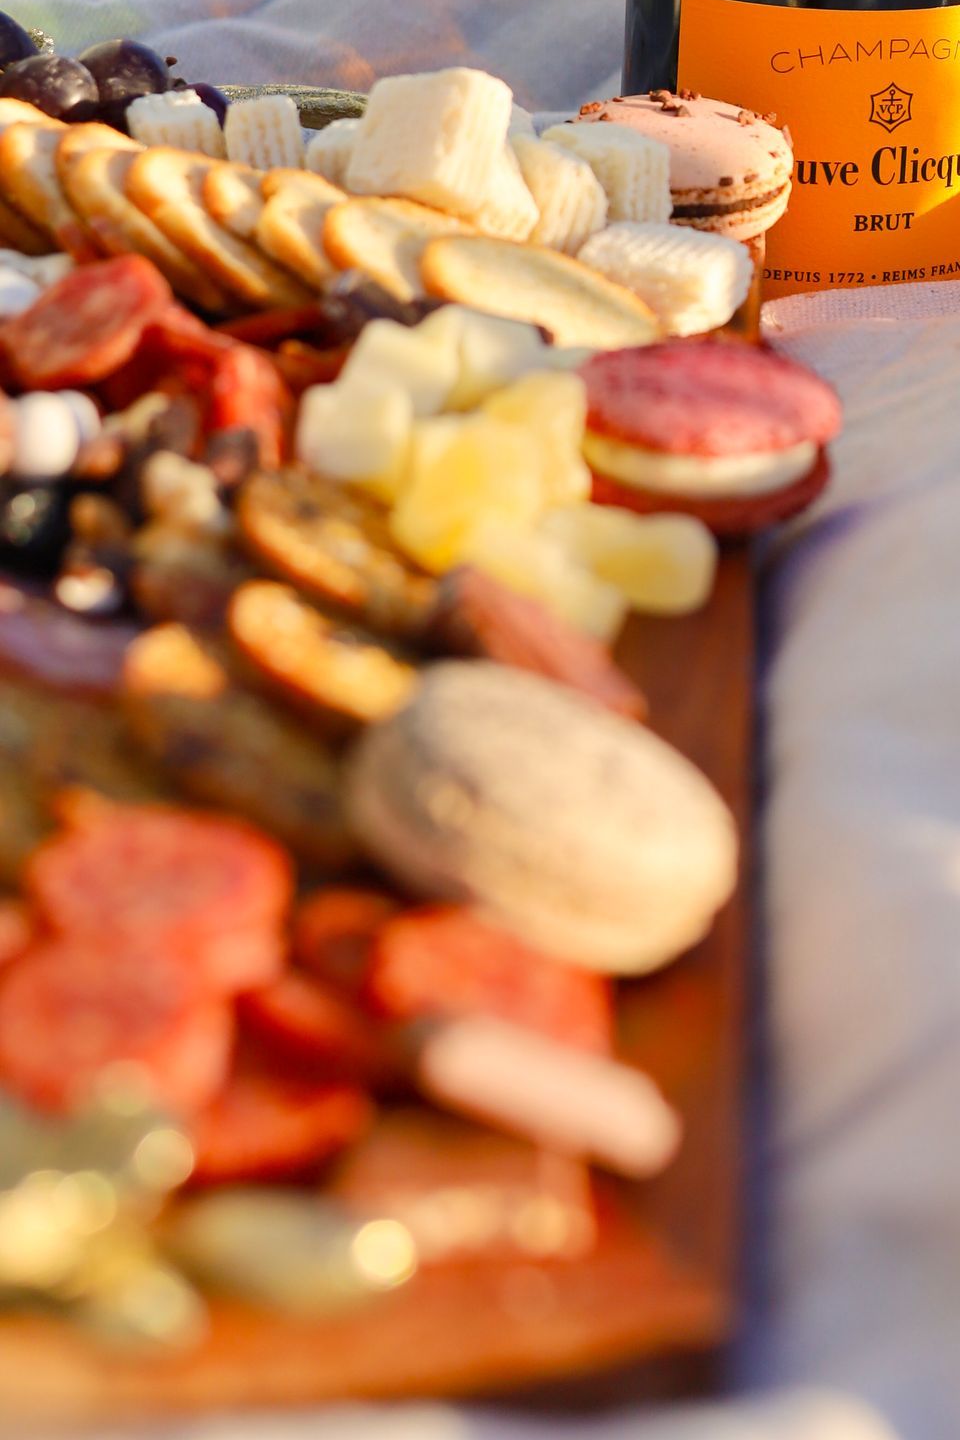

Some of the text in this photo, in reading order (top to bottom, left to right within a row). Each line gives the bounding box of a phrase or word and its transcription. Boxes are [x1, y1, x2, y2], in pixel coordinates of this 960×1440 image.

[879, 103, 904, 115] VCP
[790, 161, 859, 186] uve
[853, 212, 915, 232] BRUT
[763, 268, 821, 283] DEPUIS
[829, 272, 865, 283] 1772
[882, 268, 926, 281] REIMS
